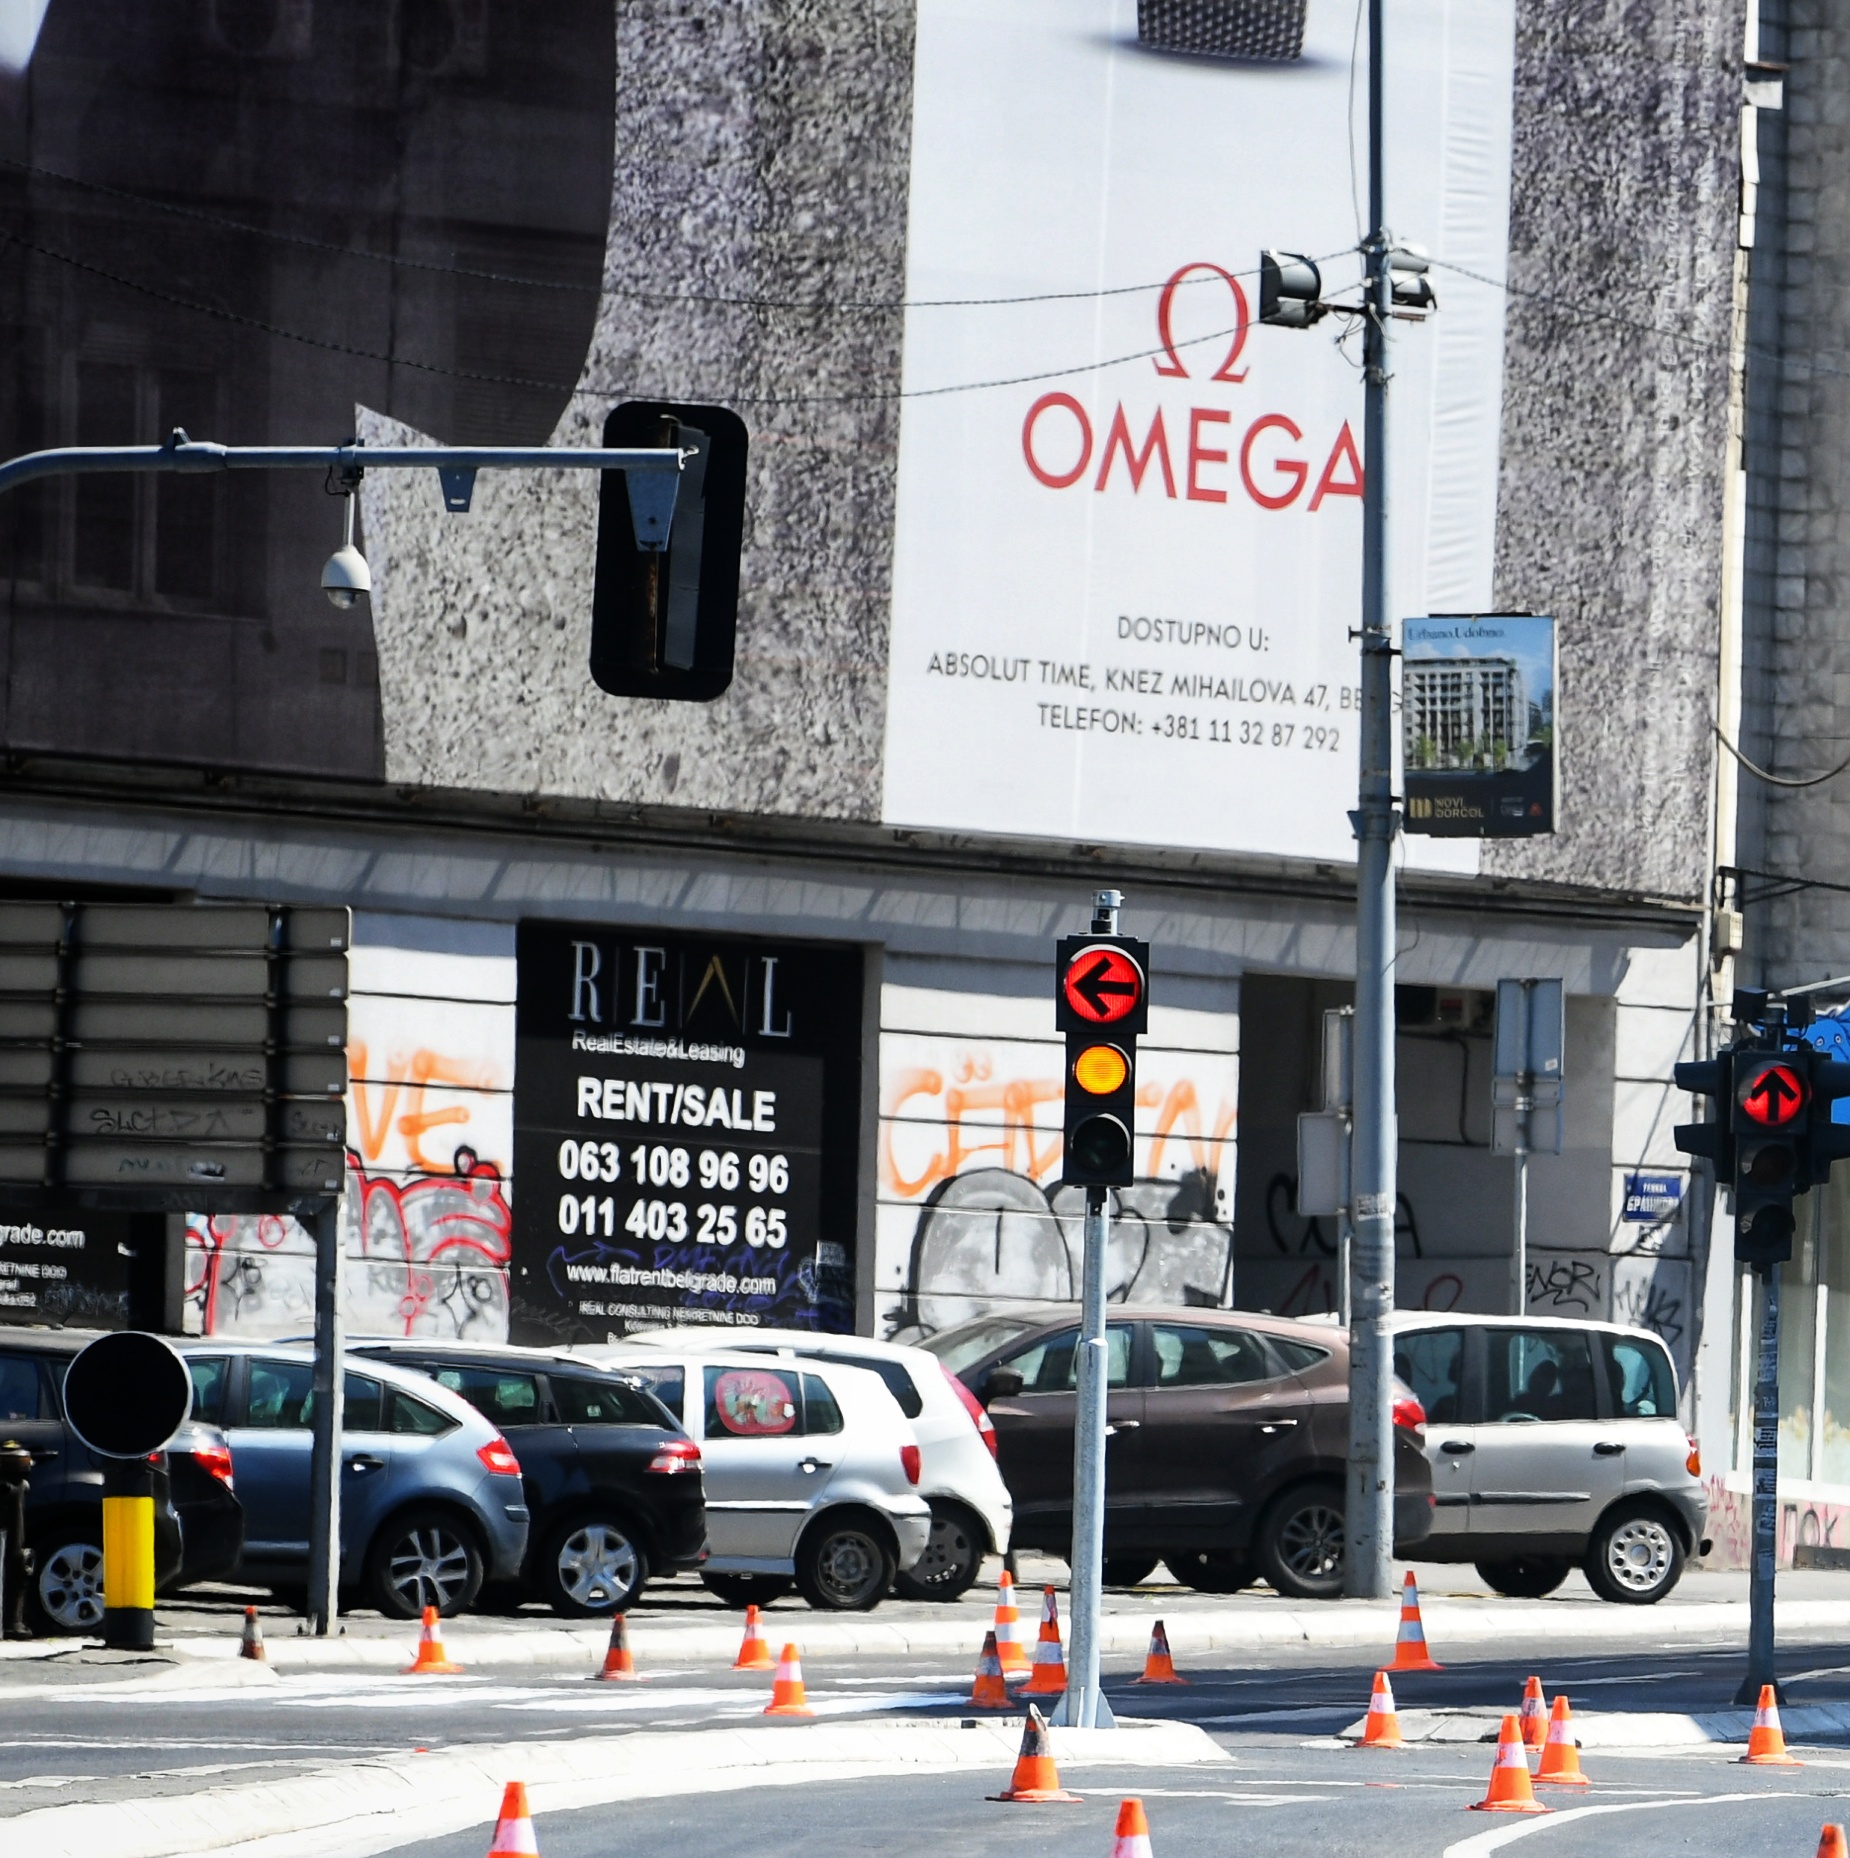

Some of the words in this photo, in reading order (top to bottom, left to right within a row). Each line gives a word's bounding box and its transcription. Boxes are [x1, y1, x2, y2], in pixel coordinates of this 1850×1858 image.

[1022, 391, 1364, 512] OMEGA
[1118, 616, 1241, 649] DOSTUPNO
[1249, 627, 1270, 652] U:
[927, 652, 1031, 683] ABSOLUT
[1038, 660, 1097, 693] TIME,
[1106, 668, 1164, 696] KNEZ
[1170, 674, 1297, 706] MIHAILOVA
[1304, 684, 1330, 713] 47,
[1038, 703, 1144, 736] TELEFON:
[1151, 715, 1200, 742] +381
[1209, 720, 1232, 744] 11
[1239, 722, 1264, 747] 32
[1271, 724, 1296, 749] 87
[1303, 727, 1341, 753] 292
[577, 1076, 776, 1132] RENT/SALE
[559, 1139, 621, 1183] 063
[630, 1144, 690, 1188] 108
[698, 1150, 740, 1191] 96
[748, 1154, 790, 1194] 96
[558, 1193, 615, 1237] 011
[625, 1198, 687, 1242] 403
[697, 1203, 738, 1246] 25
[745, 1206, 788, 1249] 65
[566, 1262, 777, 1296] www.flatrentbelgrade.com
